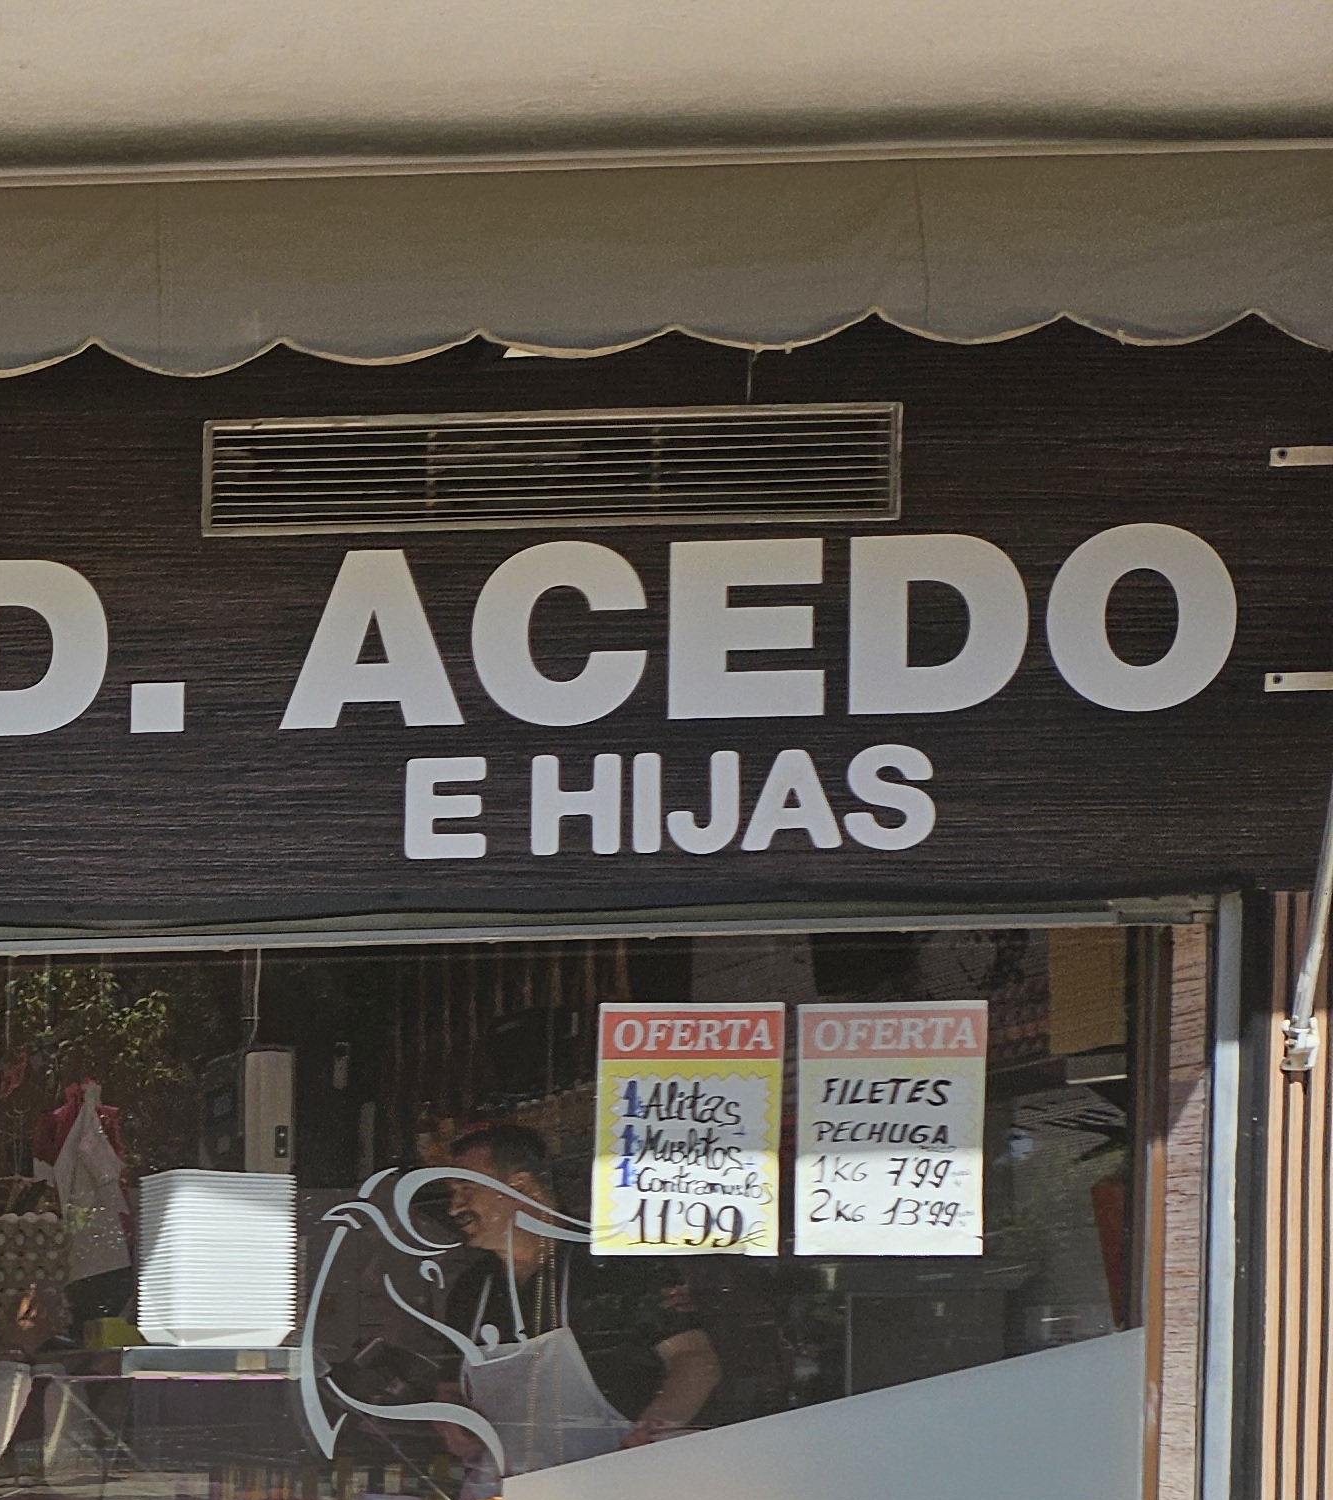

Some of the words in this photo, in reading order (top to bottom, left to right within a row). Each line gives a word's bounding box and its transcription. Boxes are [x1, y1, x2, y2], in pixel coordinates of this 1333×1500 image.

[278, 522, 1237, 730] ACEDO
[404, 756, 487, 860] E
[530, 743, 936, 856] HIJAS
[613, 1020, 773, 1052] OFERTA
[813, 1016, 977, 1052] OFERTA
[641, 1081, 741, 1127] Alitas
[821, 1078, 952, 1107] FILETES
[812, 1120, 950, 1144] PECHUGA
